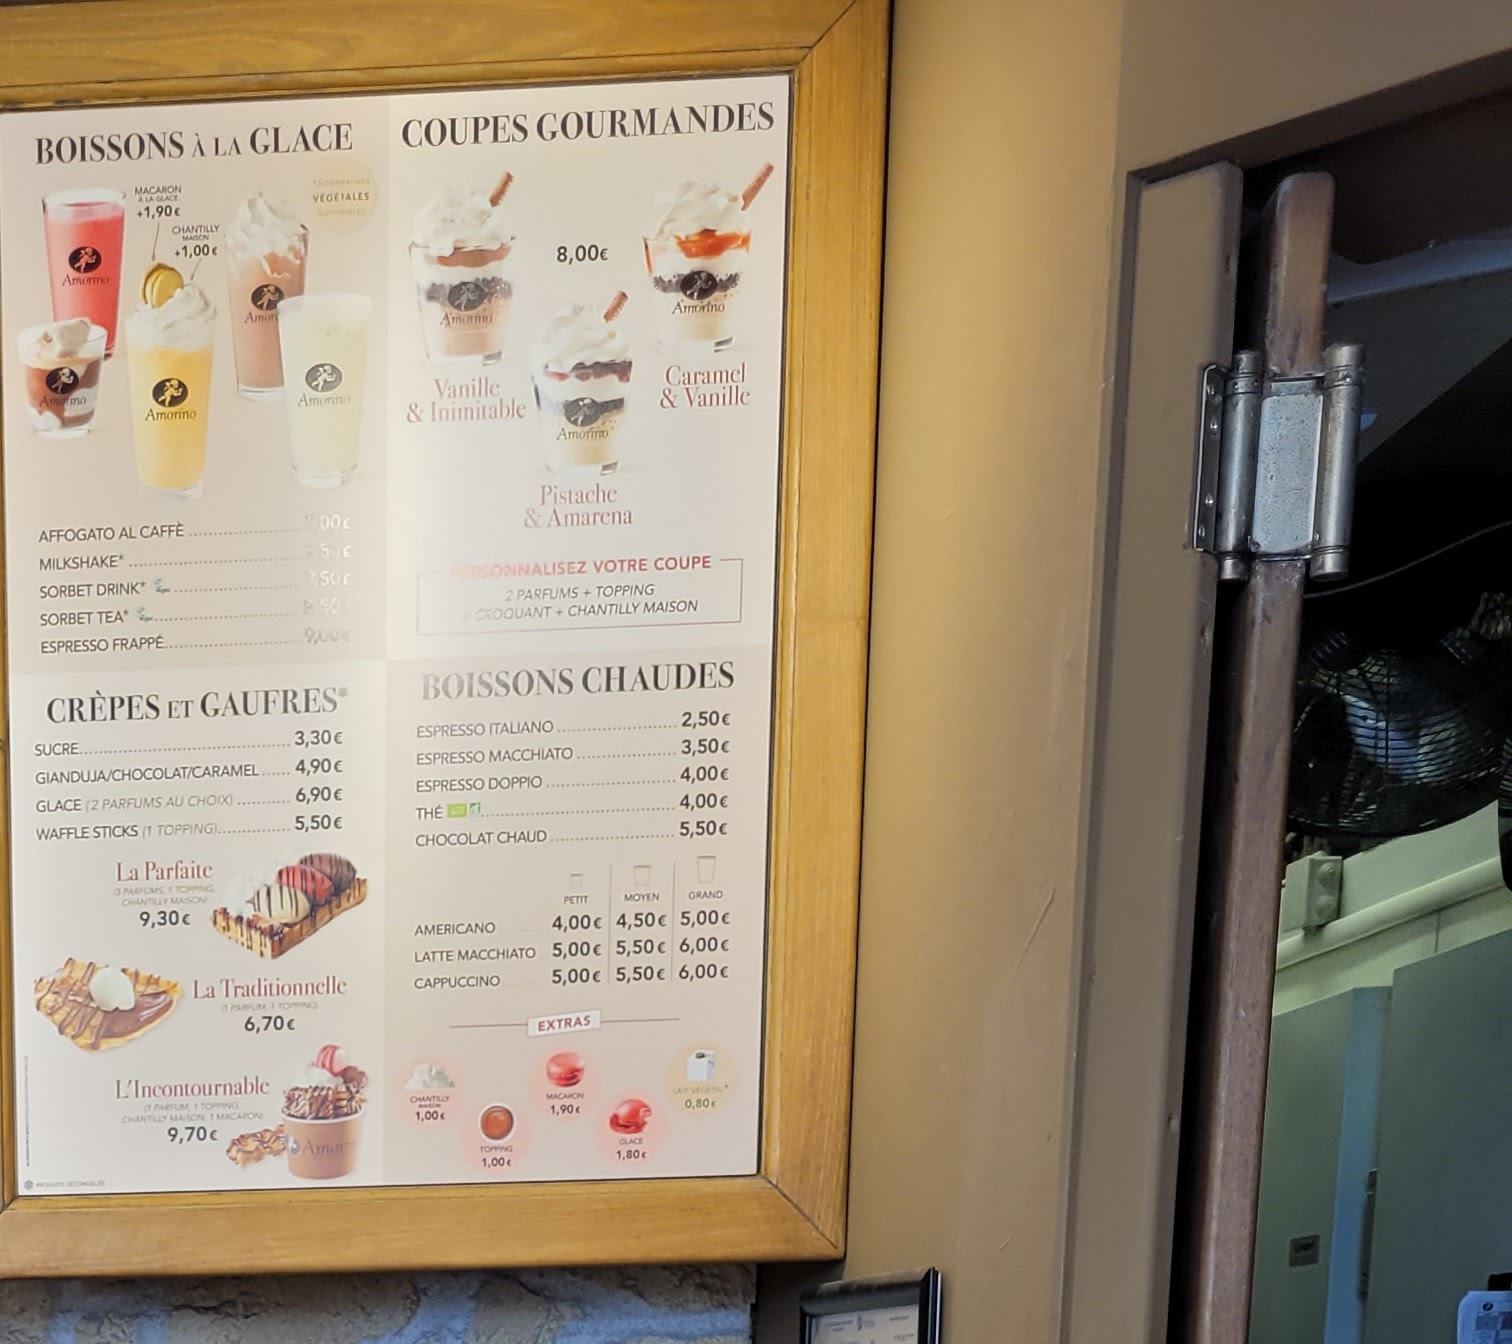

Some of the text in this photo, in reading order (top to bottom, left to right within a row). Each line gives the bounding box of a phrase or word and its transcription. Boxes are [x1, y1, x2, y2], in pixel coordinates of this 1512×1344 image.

[402, 101, 774, 148] COUPES GOURMANDES
[36, 123, 353, 165] BOISSONS À LA GLACE
[134, 185, 181, 195] MACARON
[172, 224, 220, 235] CHANTILLY
[556, 245, 608, 266] 8,00€
[666, 363, 745, 386] Caramel
[434, 378, 500, 399] Vanille
[660, 385, 750, 409] & Vanille
[406, 398, 526, 424] & Inimitable
[540, 483, 617, 506] Pistache
[524, 508, 632, 529] & Amarena
[38, 522, 184, 543] AFFOGATO AL CAFFÈ
[594, 556, 711, 574] VOTRE COUPE
[40, 584, 93, 598] SORBET
[596, 584, 655, 598] TOPPING
[567, 600, 698, 618] CHANTILLY MAISON
[40, 612, 93, 627] SORBET
[41, 635, 164, 654] ESPRESSO FRAPPÉ
[422, 661, 735, 701] BOISSONS CHAUDES
[168, 700, 194, 719] ET
[417, 720, 554, 738] ESPRESSO ITALIANO
[35, 743, 79, 757] SUCRE
[417, 747, 573, 765] ESPRESSO MACCHIATO
[416, 778, 485, 792] ESPRESSO
[488, 776, 543, 790] DOPPIO
[36, 799, 82, 813] GLACE
[416, 804, 443, 820] THÉ
[36, 826, 89, 841] WAFFLE
[93, 825, 138, 838] STICKS
[416, 832, 493, 847] CHOCOLAT
[497, 830, 547, 844] CHAUD
[116, 860, 213, 882] La Parfaite
[624, 892, 659, 902] MOYEN
[414, 922, 496, 936] AMERICANO
[414, 950, 454, 963] LATTE
[457, 947, 536, 961] MACCHIATO
[193, 976, 347, 1000] La Traditionnelle
[414, 975, 500, 990] CAPPUCCINO
[537, 1015, 591, 1032] EXTRAS
